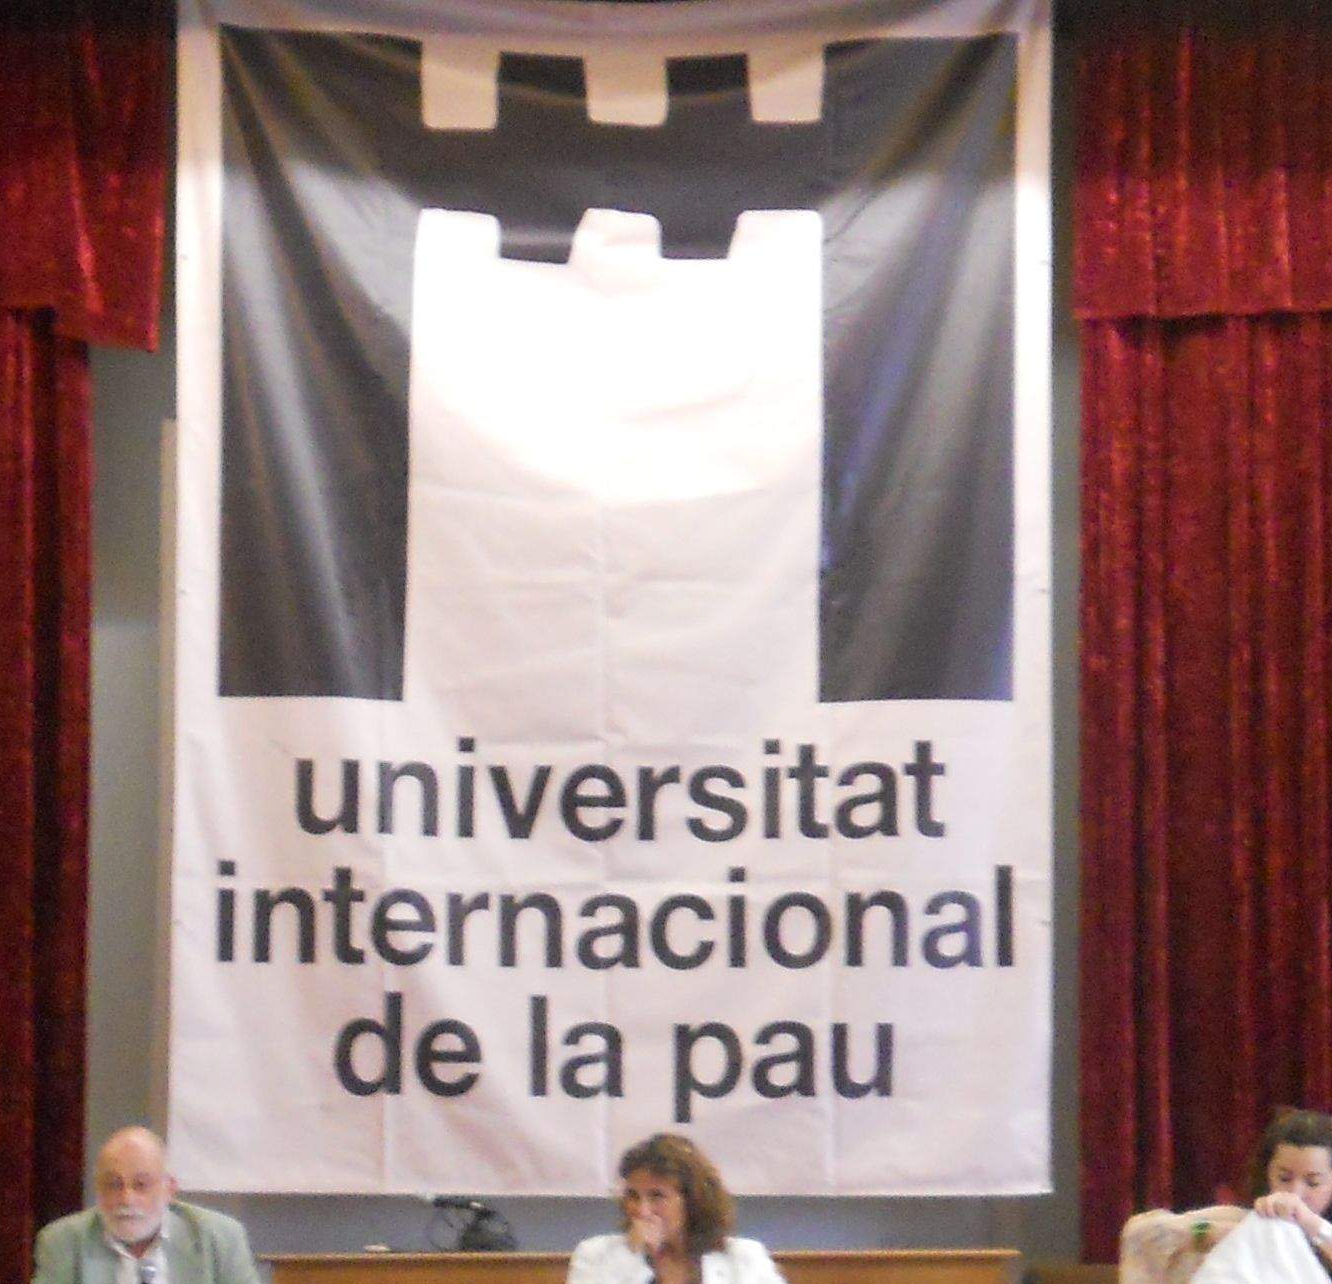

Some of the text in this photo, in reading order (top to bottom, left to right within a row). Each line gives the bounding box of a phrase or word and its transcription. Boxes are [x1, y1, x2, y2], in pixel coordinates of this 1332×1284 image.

[297, 738, 945, 842] universitat
[218, 861, 1013, 970] internacional
[334, 992, 894, 1124] de la pau
